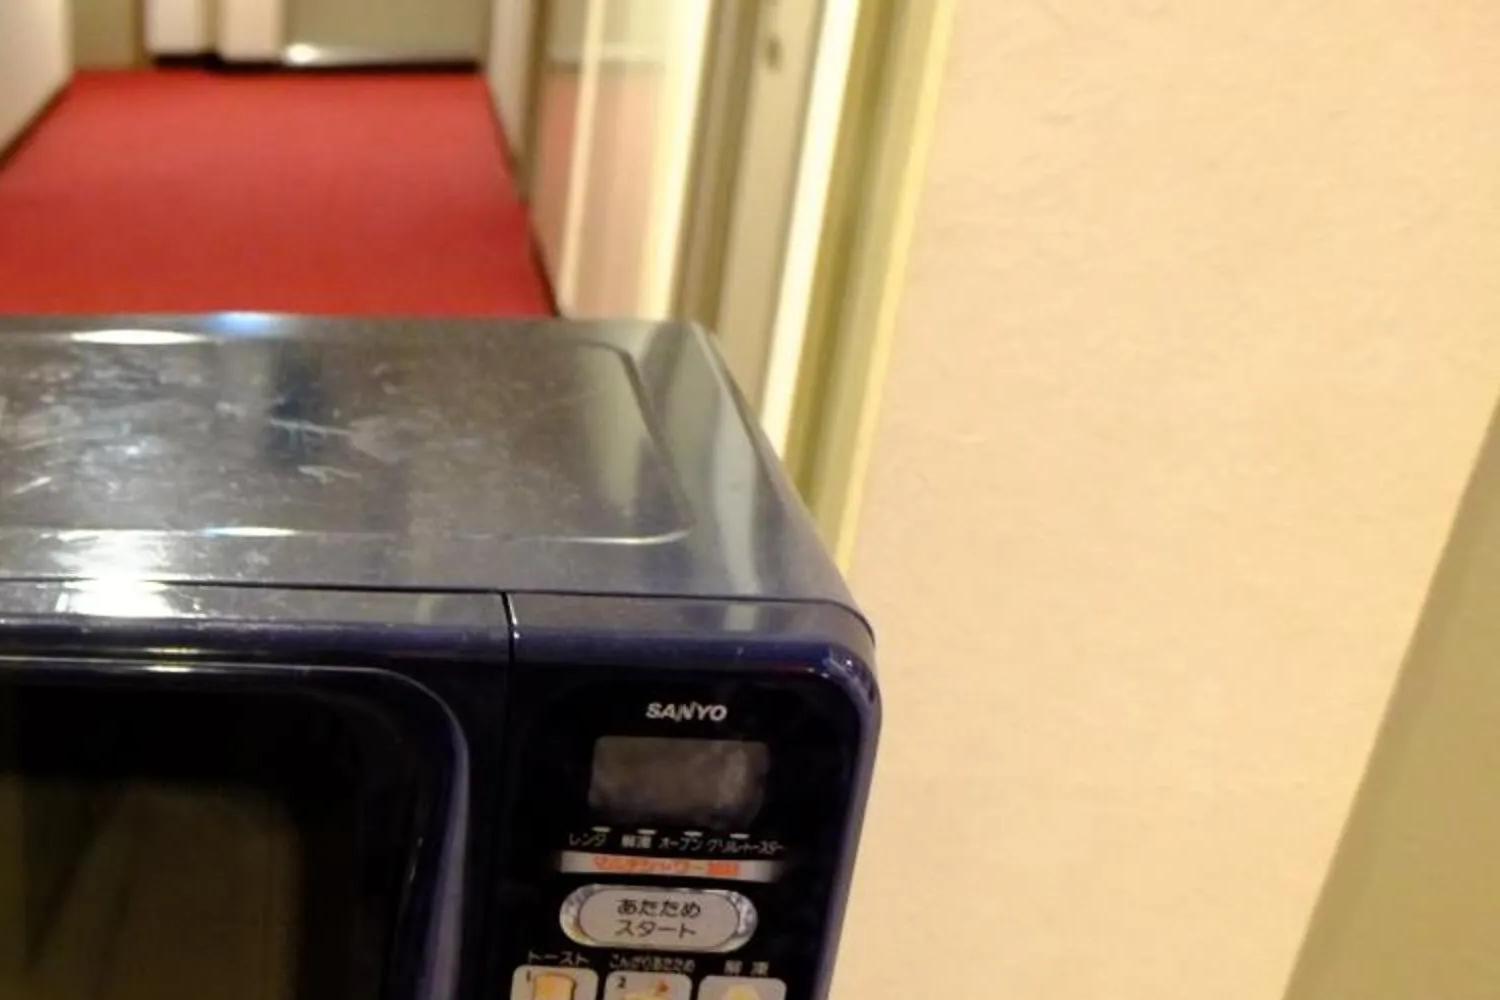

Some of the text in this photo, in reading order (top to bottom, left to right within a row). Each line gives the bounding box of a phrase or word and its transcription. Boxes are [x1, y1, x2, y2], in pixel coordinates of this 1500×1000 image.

[645, 701, 728, 722] SANYO
[616, 898, 701, 919] あたため
[614, 919, 697, 940] スタート
